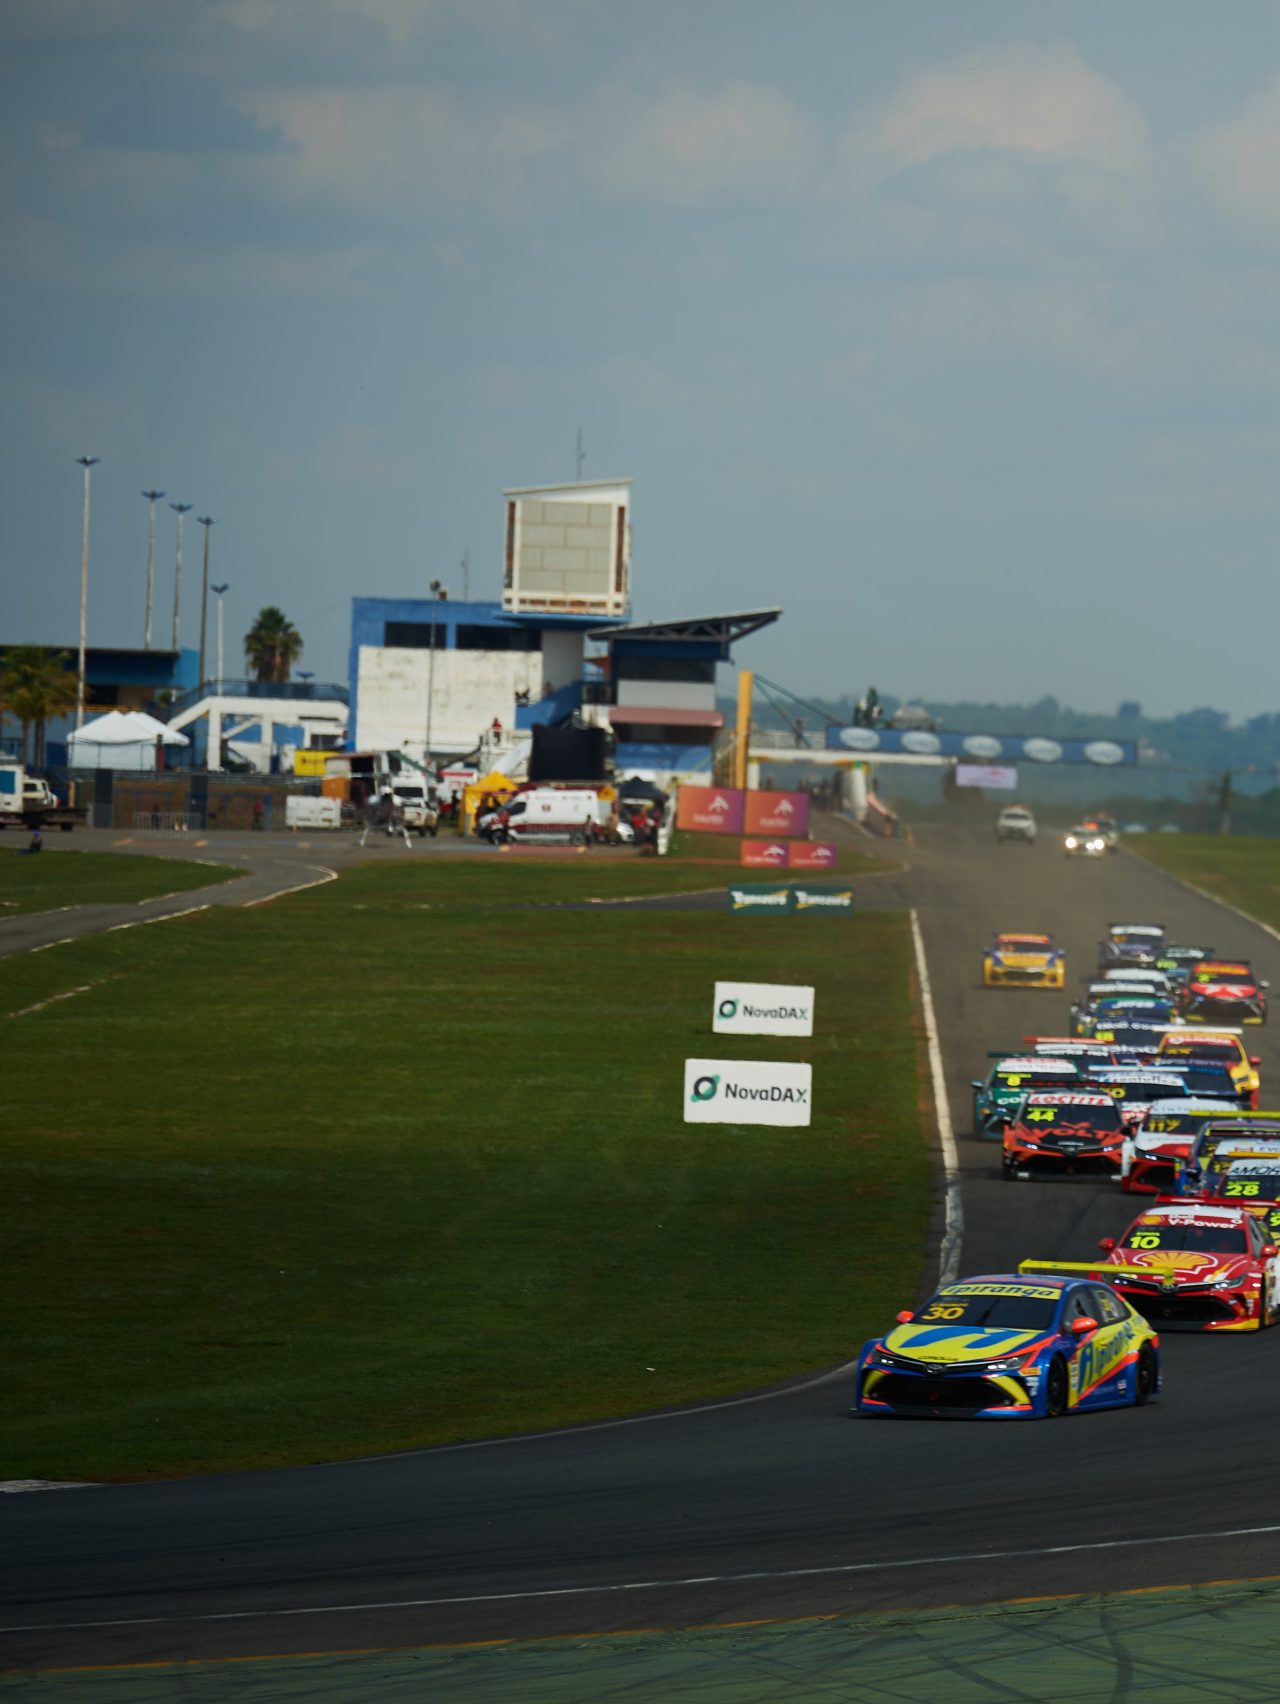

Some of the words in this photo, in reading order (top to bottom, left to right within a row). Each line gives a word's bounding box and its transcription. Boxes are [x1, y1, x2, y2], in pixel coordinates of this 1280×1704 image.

[743, 1005, 808, 1020] NovaDAX
[725, 1083, 807, 1103] NovaDAX
[1030, 1096, 1106, 1105] LOCTITE
[1026, 1110, 1055, 1121] 44
[1224, 1184, 1260, 1197] 28
[1169, 1219, 1238, 1229] V-Power
[1130, 1236, 1160, 1249] 10
[921, 1307, 966, 1320] 30
